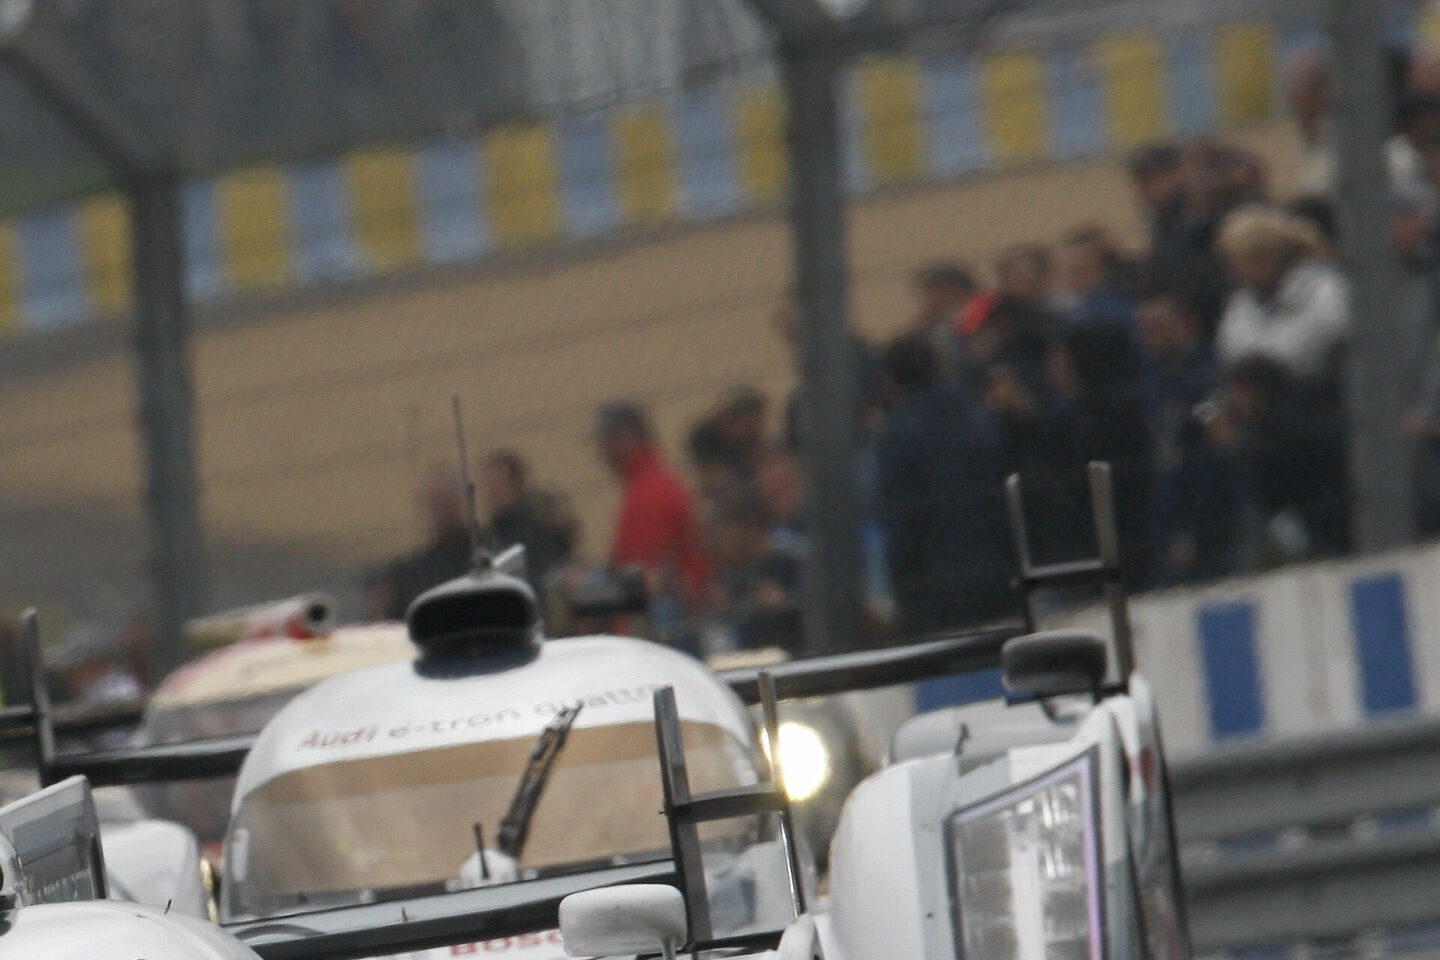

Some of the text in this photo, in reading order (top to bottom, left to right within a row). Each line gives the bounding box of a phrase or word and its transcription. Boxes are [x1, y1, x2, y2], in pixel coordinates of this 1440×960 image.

[299, 725, 378, 750] Audi
[388, 708, 521, 738] e-tron
[451, 929, 563, 957] BOSC
